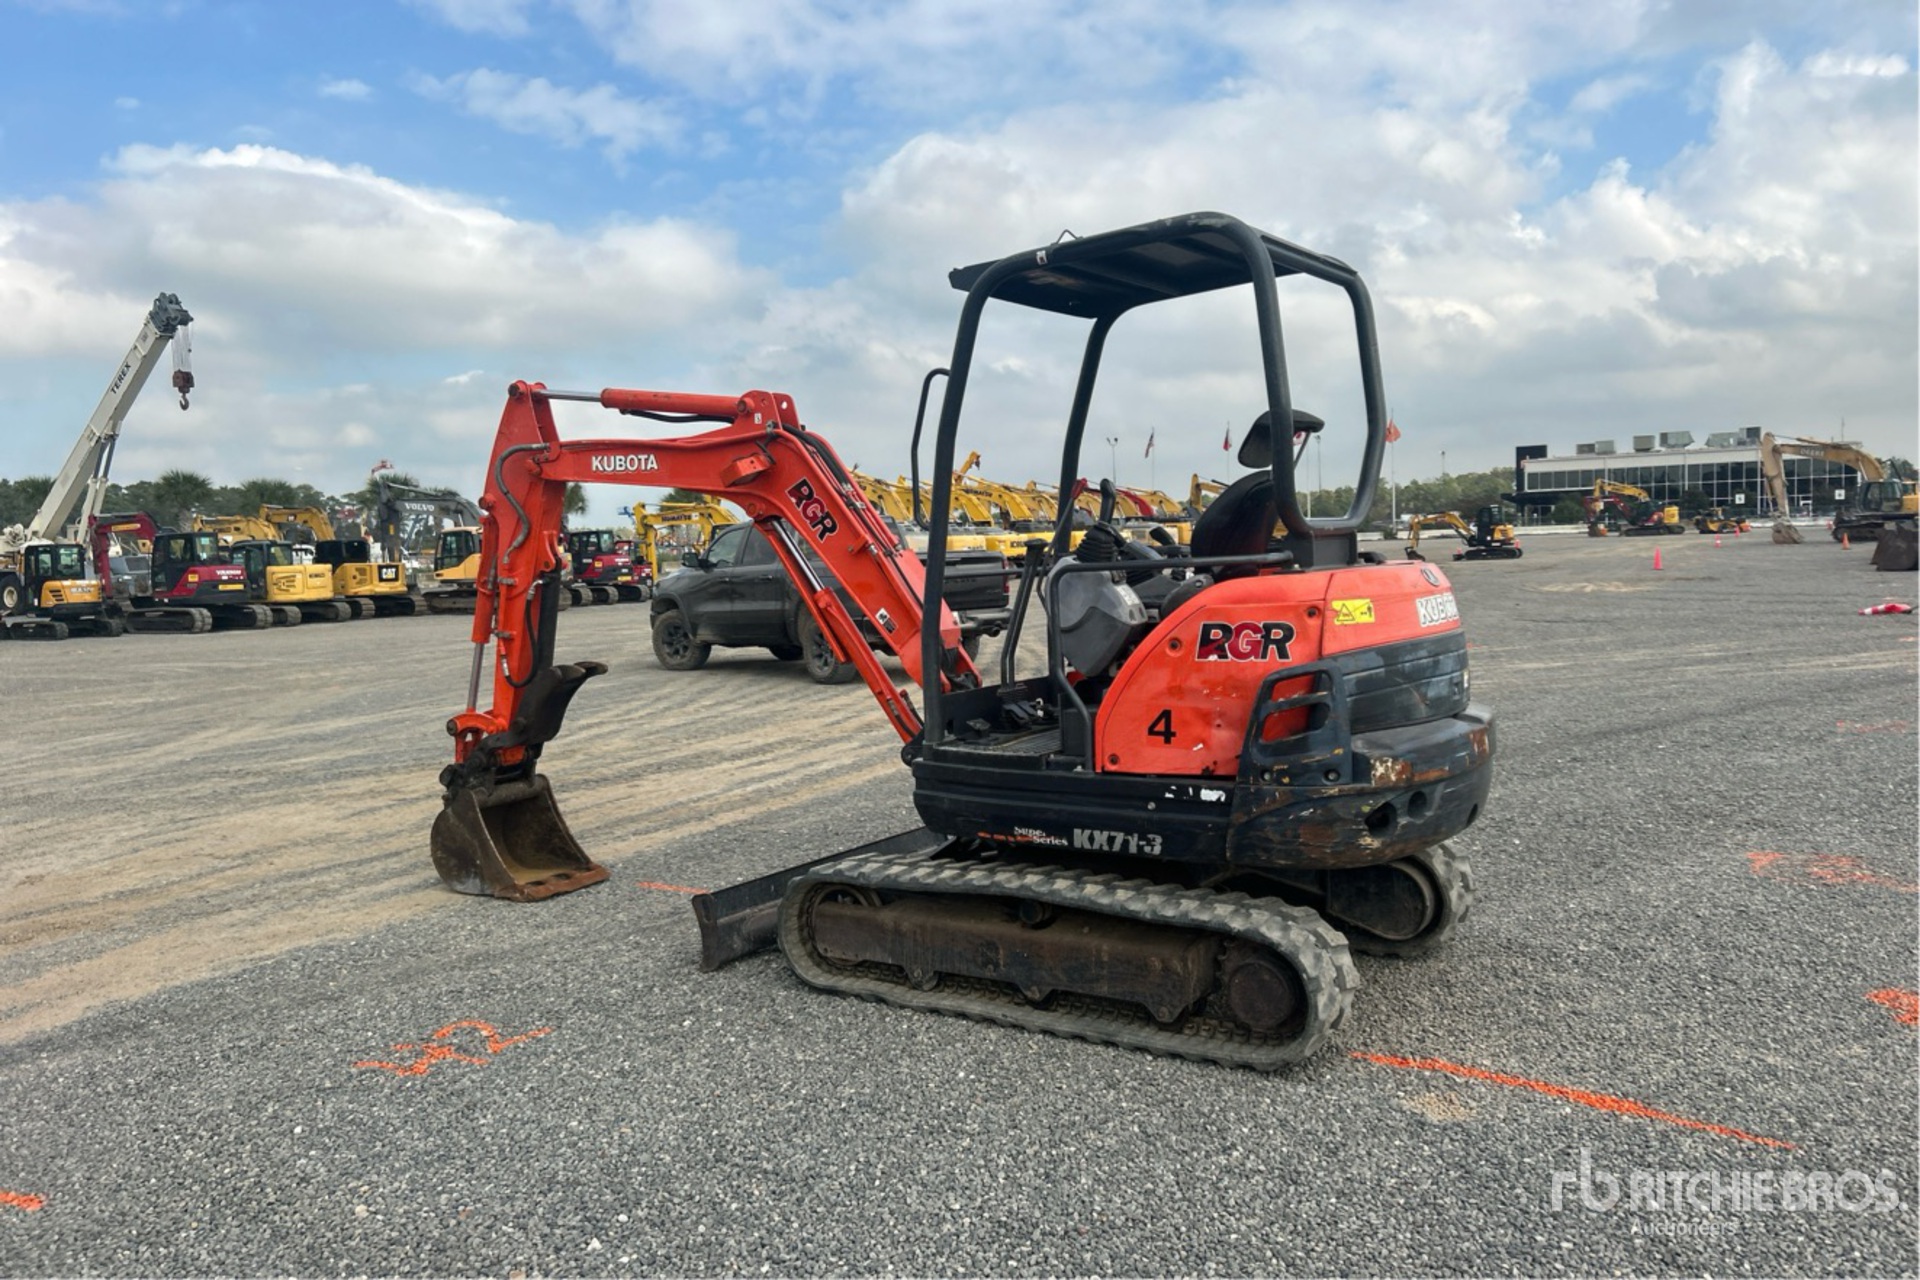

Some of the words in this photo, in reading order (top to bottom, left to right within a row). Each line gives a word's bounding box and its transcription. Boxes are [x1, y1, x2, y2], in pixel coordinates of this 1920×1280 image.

[110, 361, 131, 394] TEREX
[592, 454, 658, 472] KUBOTA
[404, 502, 435, 512] VOLVO
[785, 475, 839, 543] RGR
[382, 568, 396, 579] CAT
[1416, 592, 1459, 627] KUB
[1195, 621, 1296, 662] RGR
[1147, 708, 1177, 745] 4
[1013, 826, 1047, 837] Supe
[1033, 835, 1069, 846] Series
[1073, 828, 1163, 855] KX71-3
